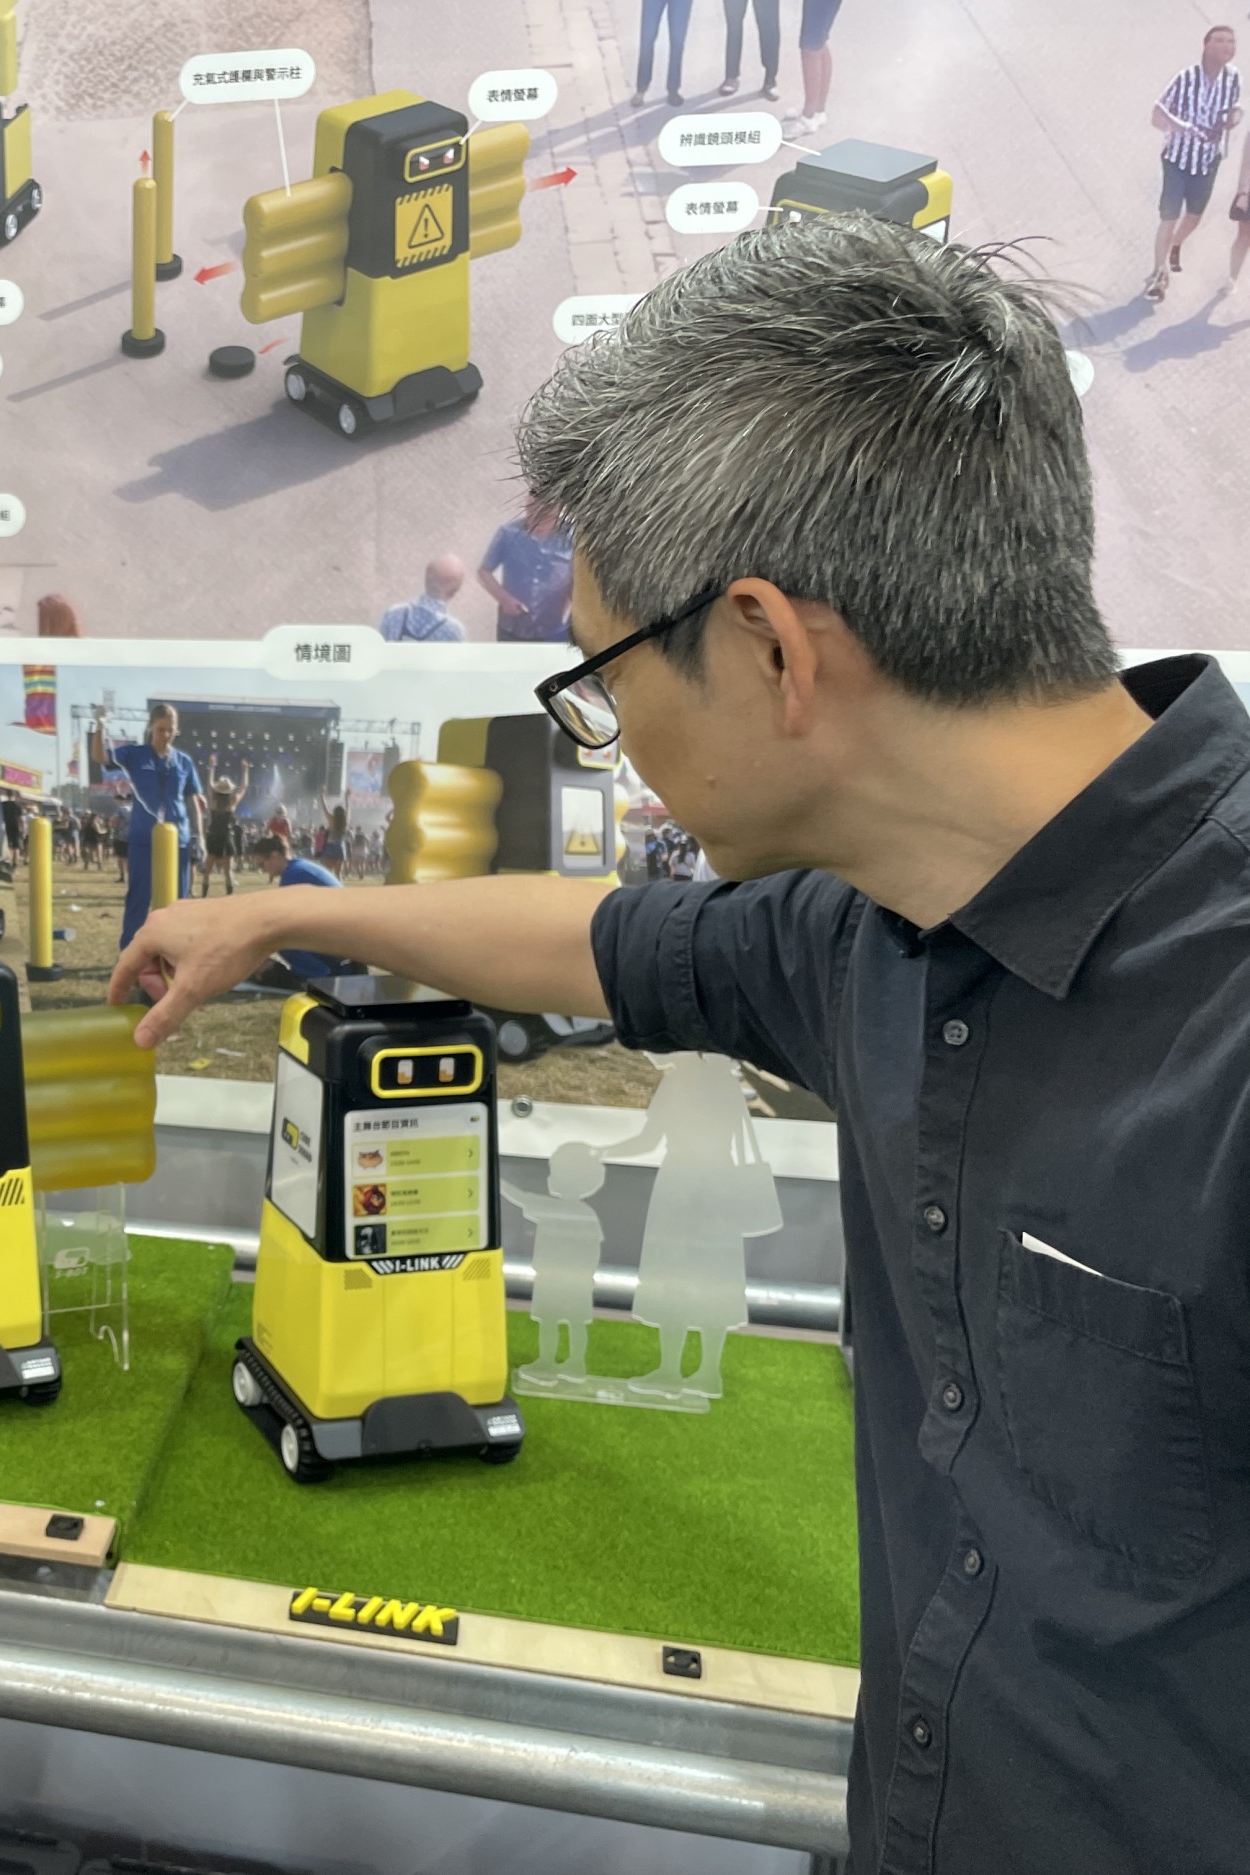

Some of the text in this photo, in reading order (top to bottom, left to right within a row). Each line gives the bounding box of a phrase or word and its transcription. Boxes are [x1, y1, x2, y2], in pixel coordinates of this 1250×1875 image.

[486, 87, 539, 102] 表情螢幕
[685, 201, 739, 216] 表情螢幕
[571, 312, 630, 327] 四面大型
[294, 643, 352, 664] 情境圖
[395, 1256, 441, 1273] I-LINK
[291, 1586, 458, 1637] I-LINK
